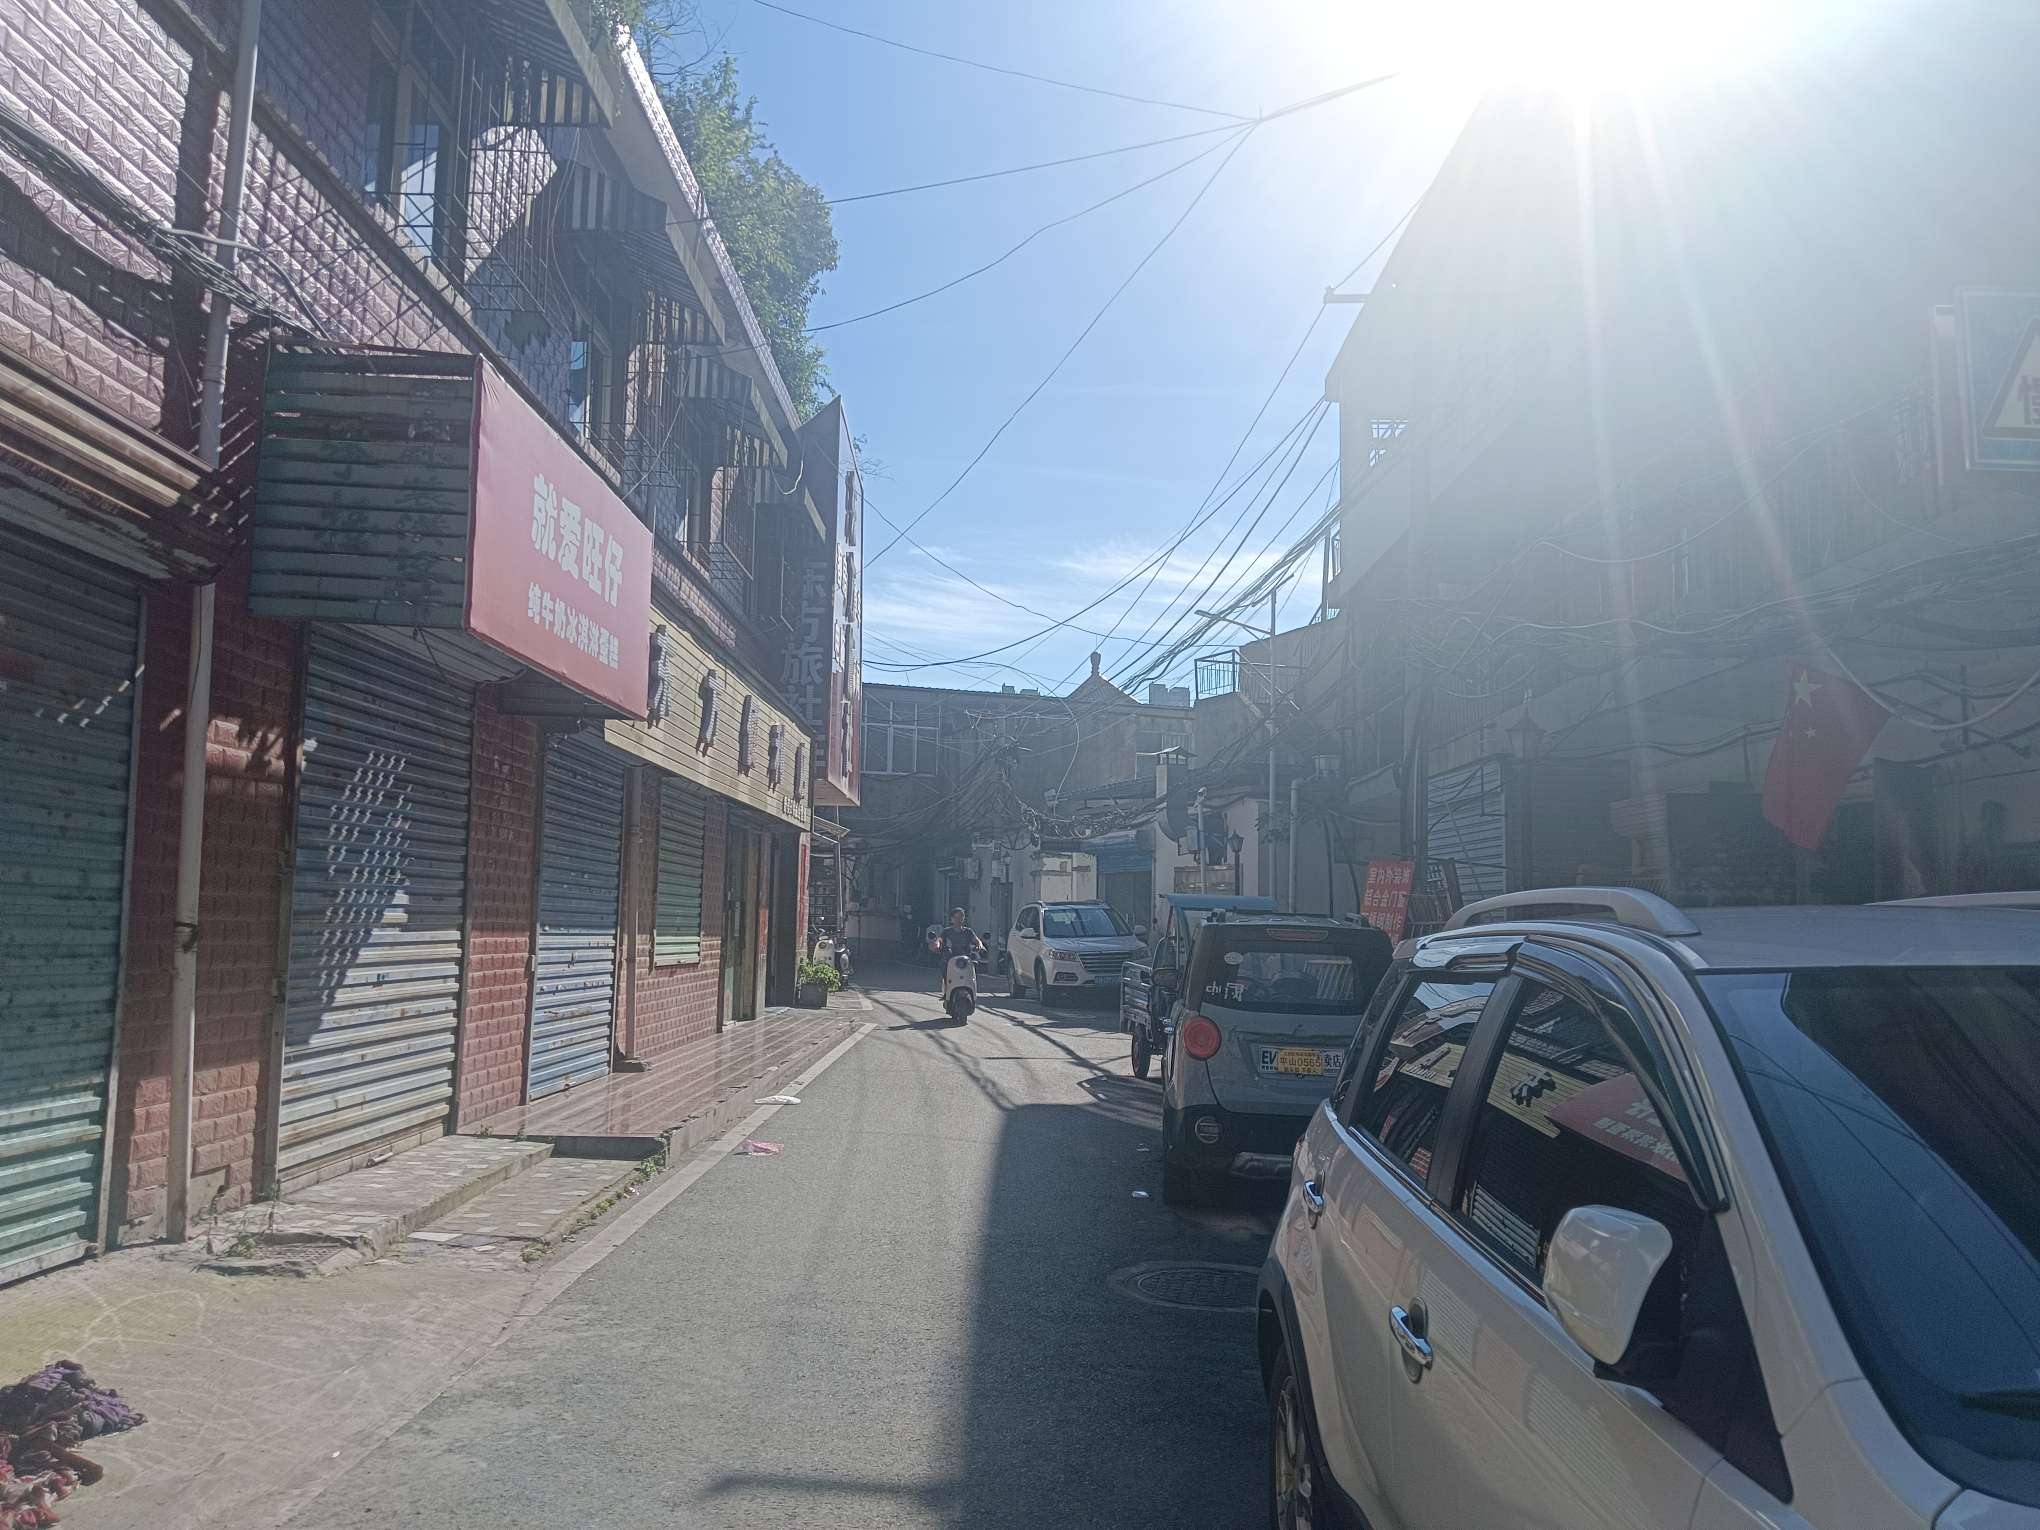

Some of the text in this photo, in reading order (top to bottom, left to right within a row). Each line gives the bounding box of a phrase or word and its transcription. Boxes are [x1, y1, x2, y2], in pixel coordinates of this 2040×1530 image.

[531, 473, 624, 608] 就爱旺仔
[527, 581, 620, 671] 纯牛奶冰淇淋蛋糕
[1361, 912, 1402, 931] 锈钢制作
